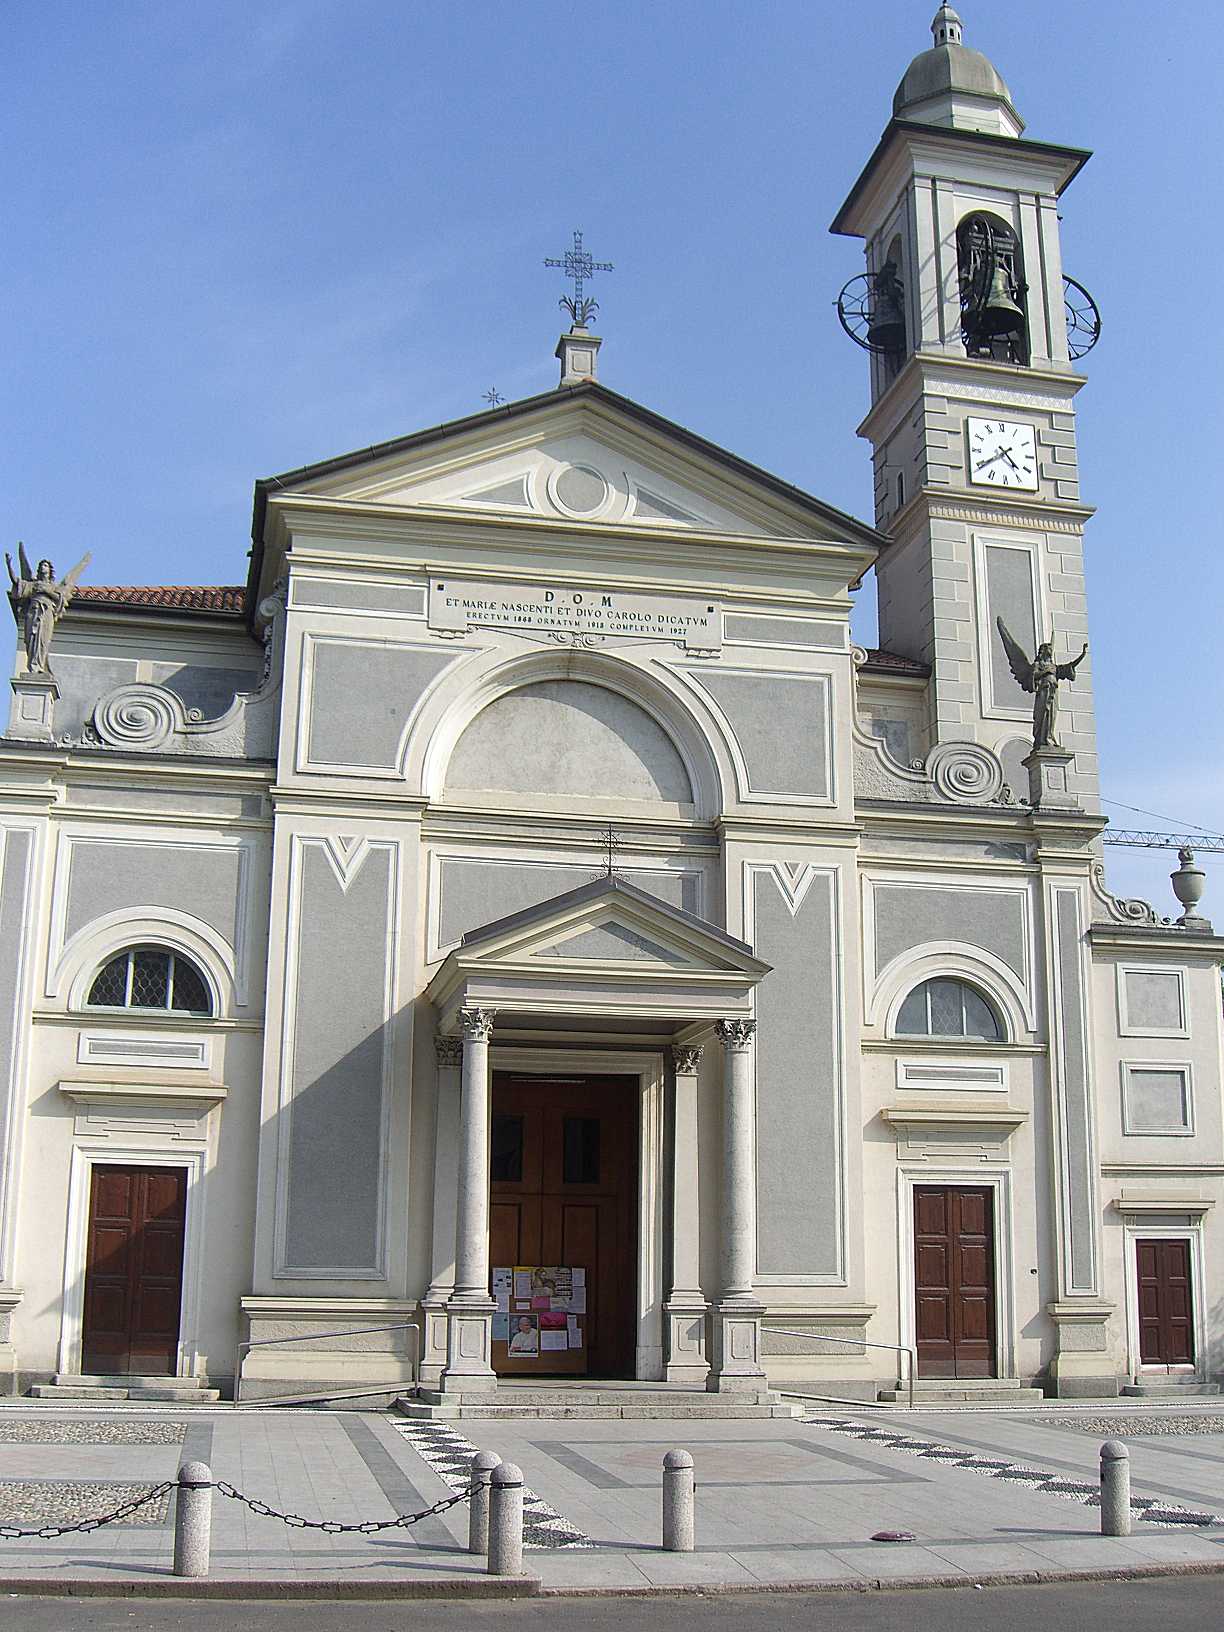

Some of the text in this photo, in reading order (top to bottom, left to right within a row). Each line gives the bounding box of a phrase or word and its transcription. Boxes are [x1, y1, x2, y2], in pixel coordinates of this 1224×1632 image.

[446, 598, 708, 627] ET MARIÆ NASCENTI ET DIVO CAROLO DICATVM
[466, 611, 510, 621] ERECTVM
[537, 617, 580, 627] ORNATVM
[609, 623, 664, 633] COMPLETVM
[670, 627, 687, 635] 1927
